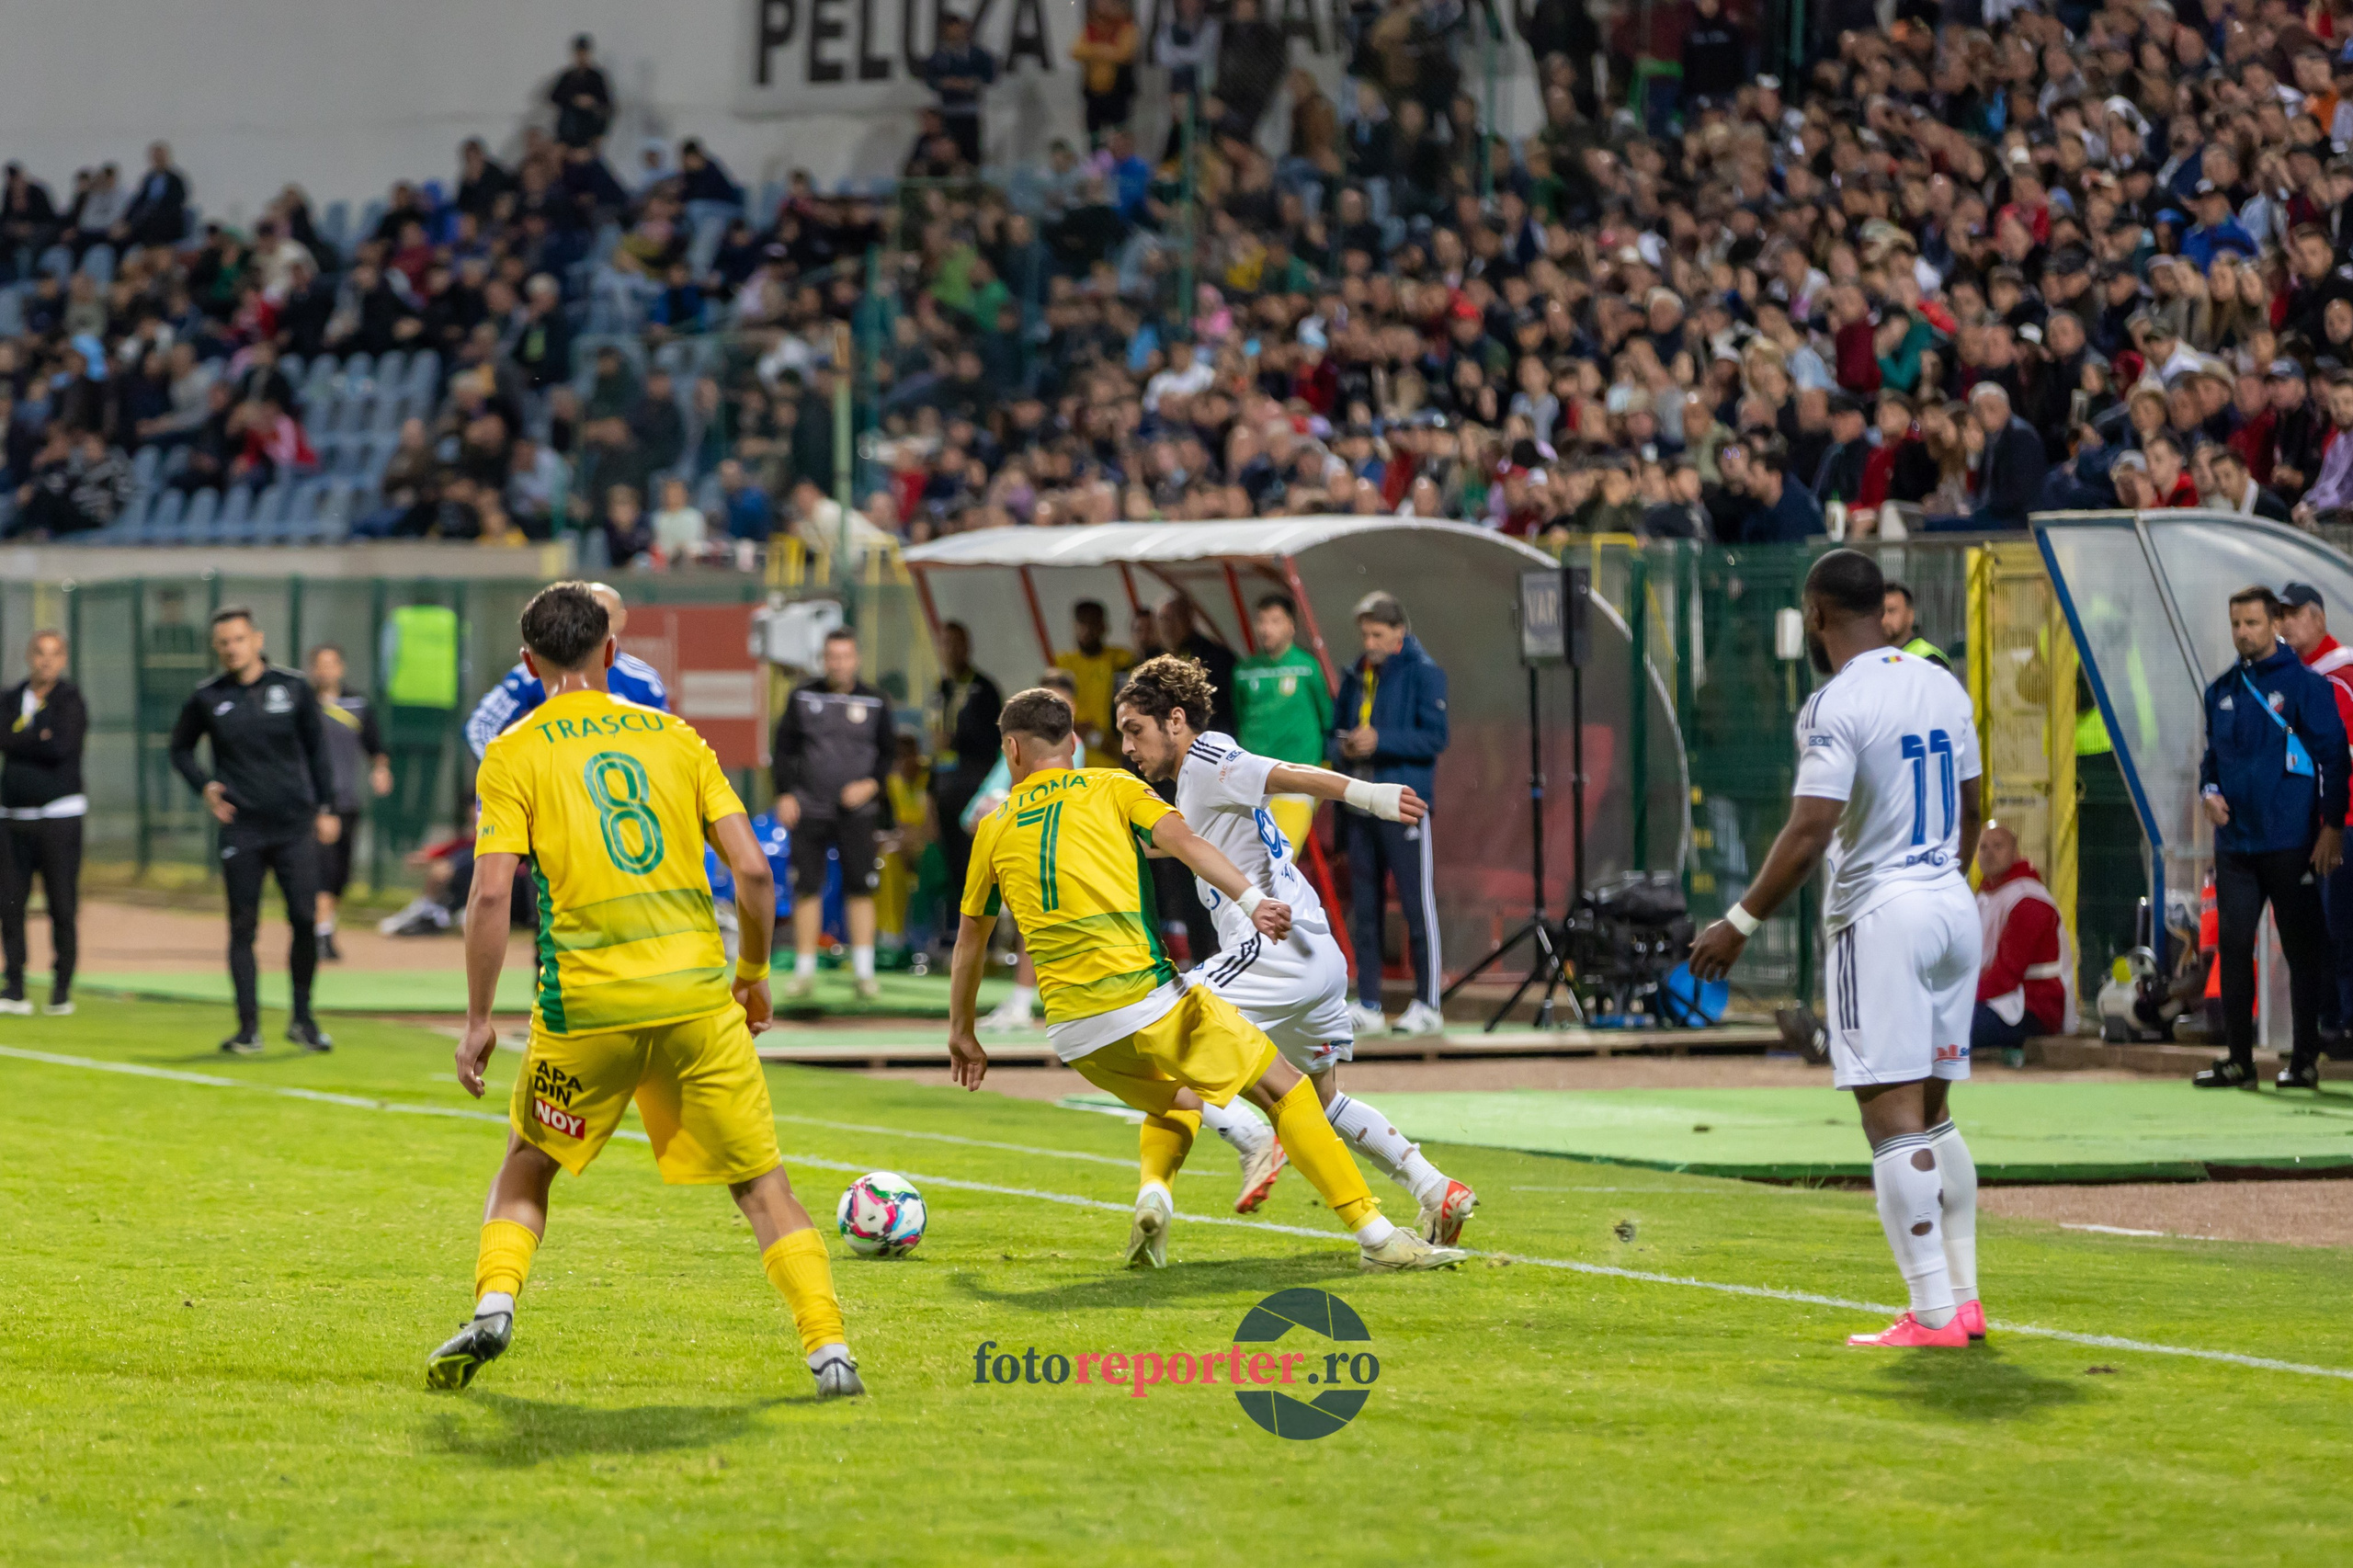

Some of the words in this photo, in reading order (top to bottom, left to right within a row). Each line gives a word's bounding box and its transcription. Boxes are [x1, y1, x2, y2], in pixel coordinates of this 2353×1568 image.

[756, 0, 1054, 85] PELUA
[1017, 774, 1087, 807] TOMA
[1902, 729, 1955, 846] 11
[584, 751, 665, 876] 8
[534, 1075, 572, 1108] DIN
[536, 1060, 584, 1093] APA
[535, 1099, 582, 1136] NOY
